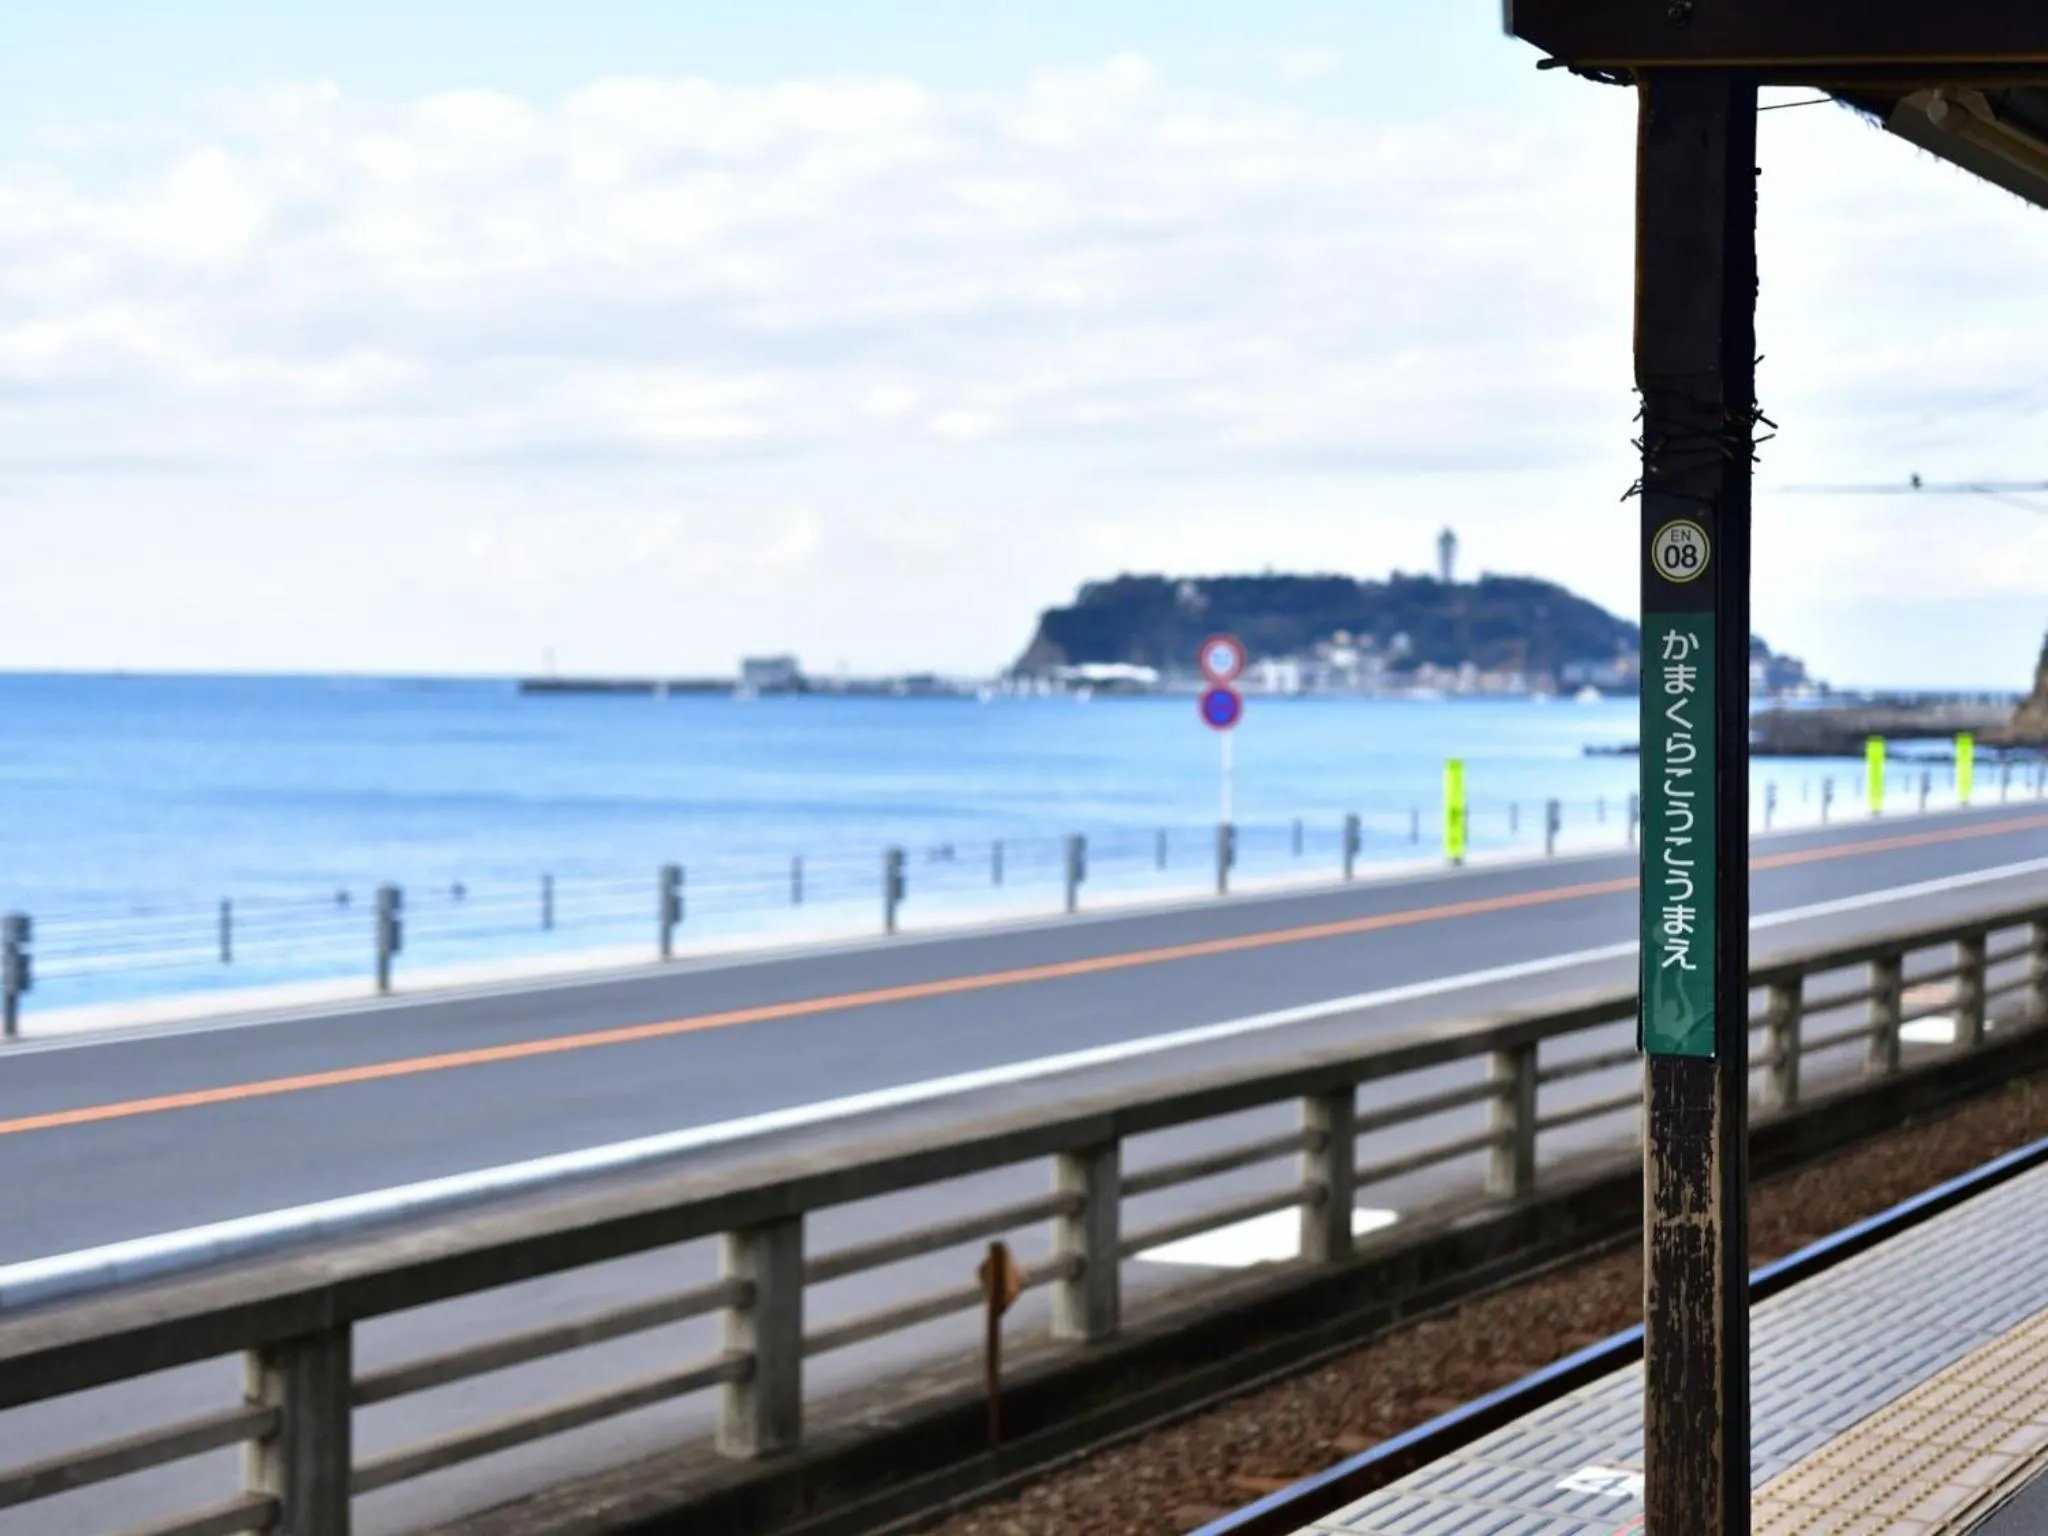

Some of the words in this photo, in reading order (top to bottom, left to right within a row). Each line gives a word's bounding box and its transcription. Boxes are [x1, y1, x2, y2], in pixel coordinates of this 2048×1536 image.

[1670, 529, 1691, 542] EN
[1664, 544, 1697, 568] 08
[1662, 629, 1699, 970] かまくらこうこうまえ
